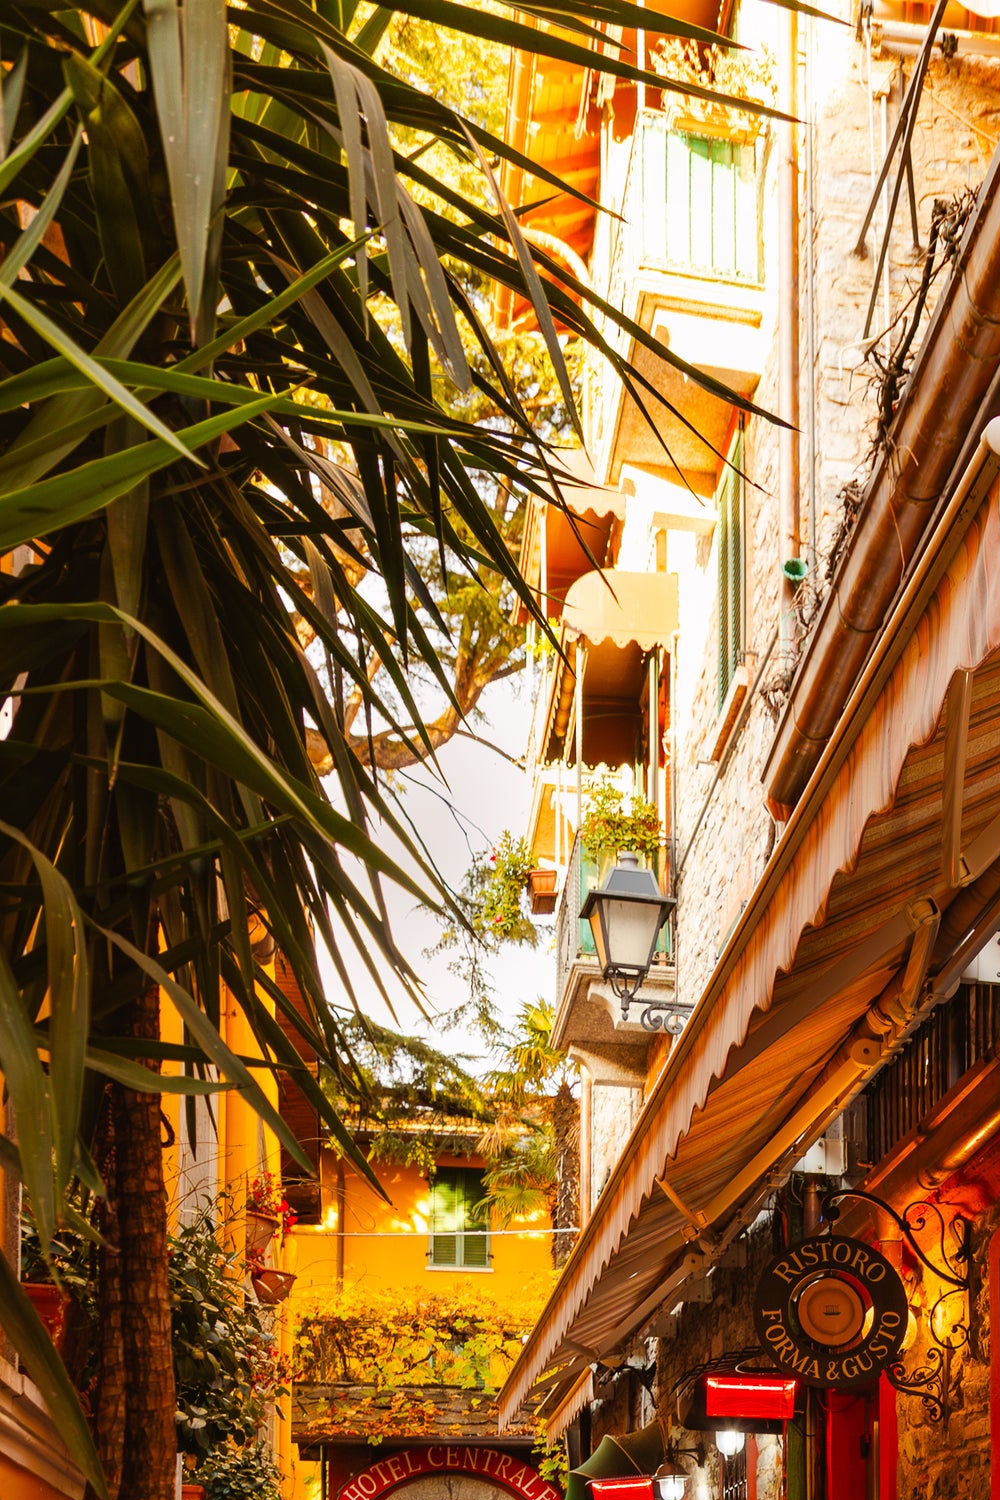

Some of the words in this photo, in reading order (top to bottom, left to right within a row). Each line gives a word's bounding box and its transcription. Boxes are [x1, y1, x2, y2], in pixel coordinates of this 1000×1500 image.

[773, 1241, 887, 1284] RISTORO
[761, 1308, 821, 1379] FORMA
[826, 1360, 841, 1381] &
[841, 1311, 901, 1378] GUSTO
